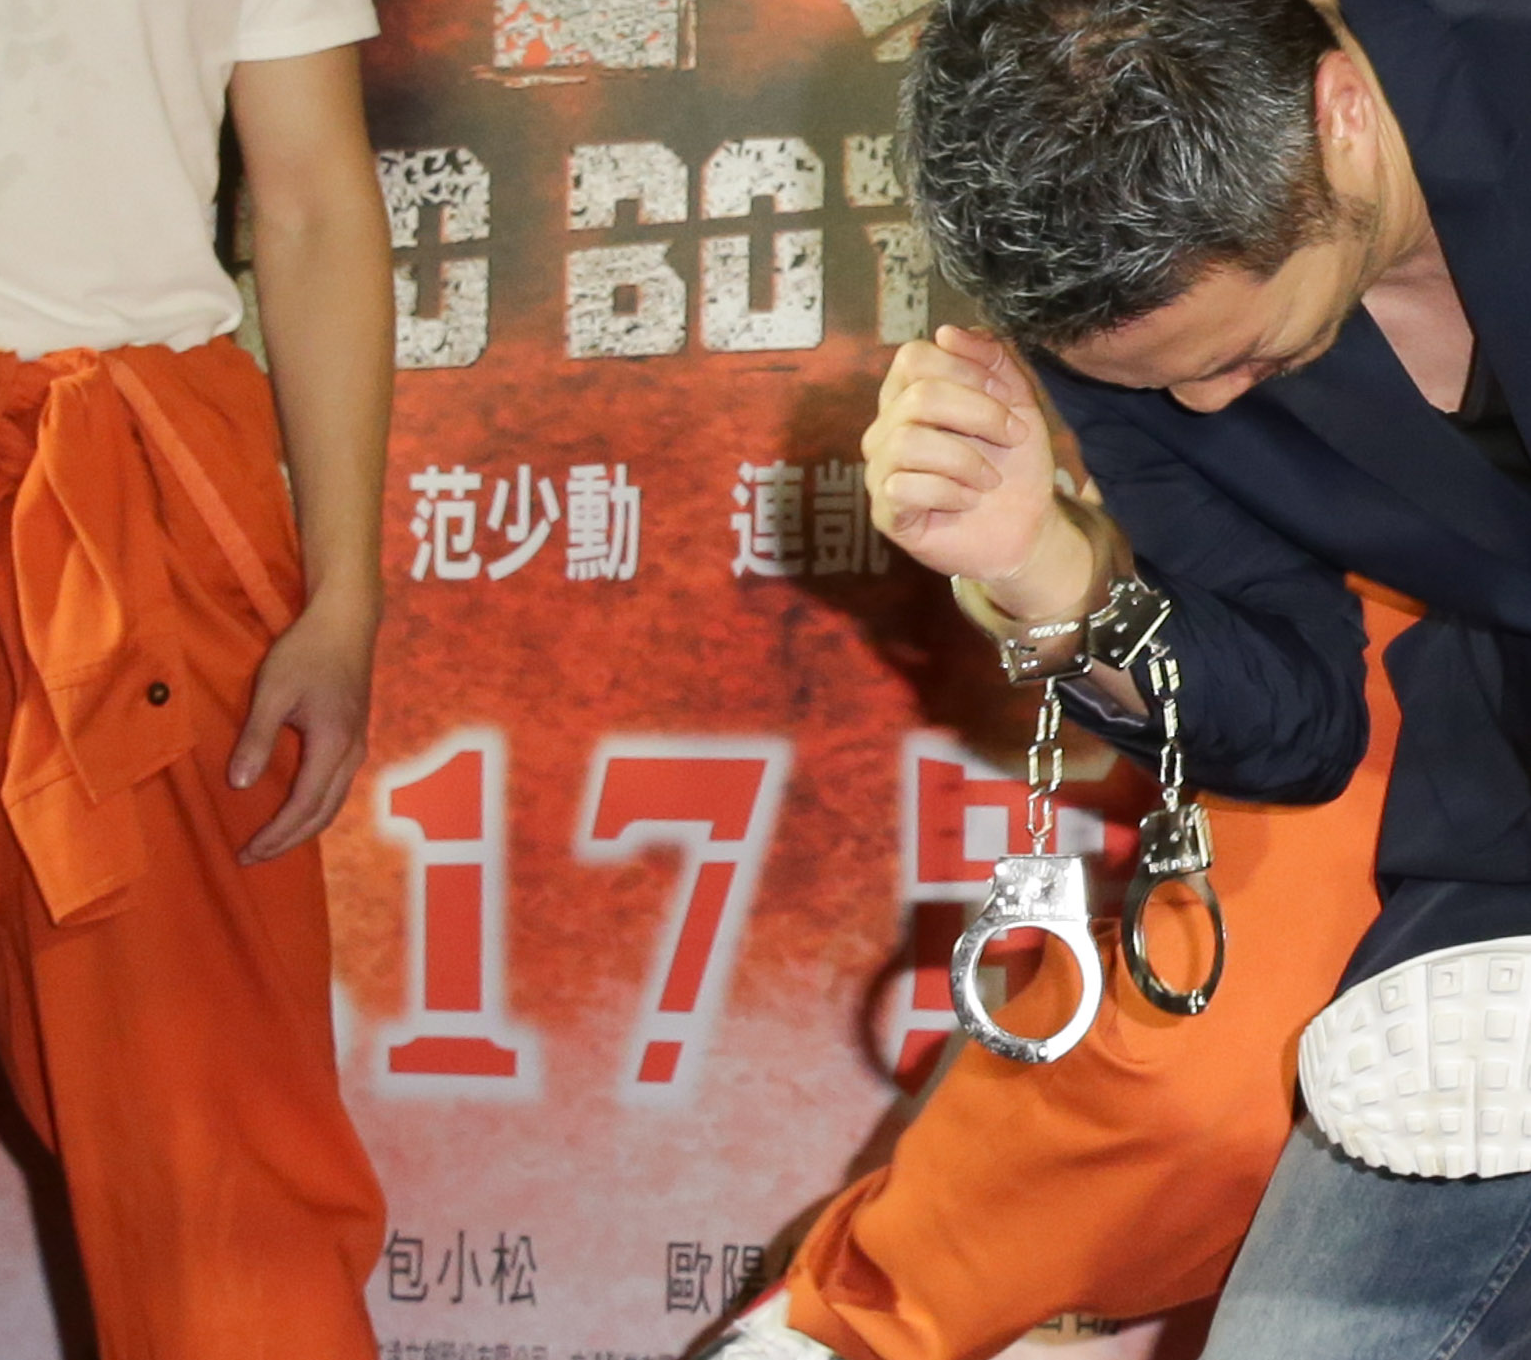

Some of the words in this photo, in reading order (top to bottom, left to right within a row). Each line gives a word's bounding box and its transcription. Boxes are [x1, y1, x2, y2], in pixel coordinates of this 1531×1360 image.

[408, 463, 642, 582] 范少勳
[384, 1229, 538, 1307] 包小松
